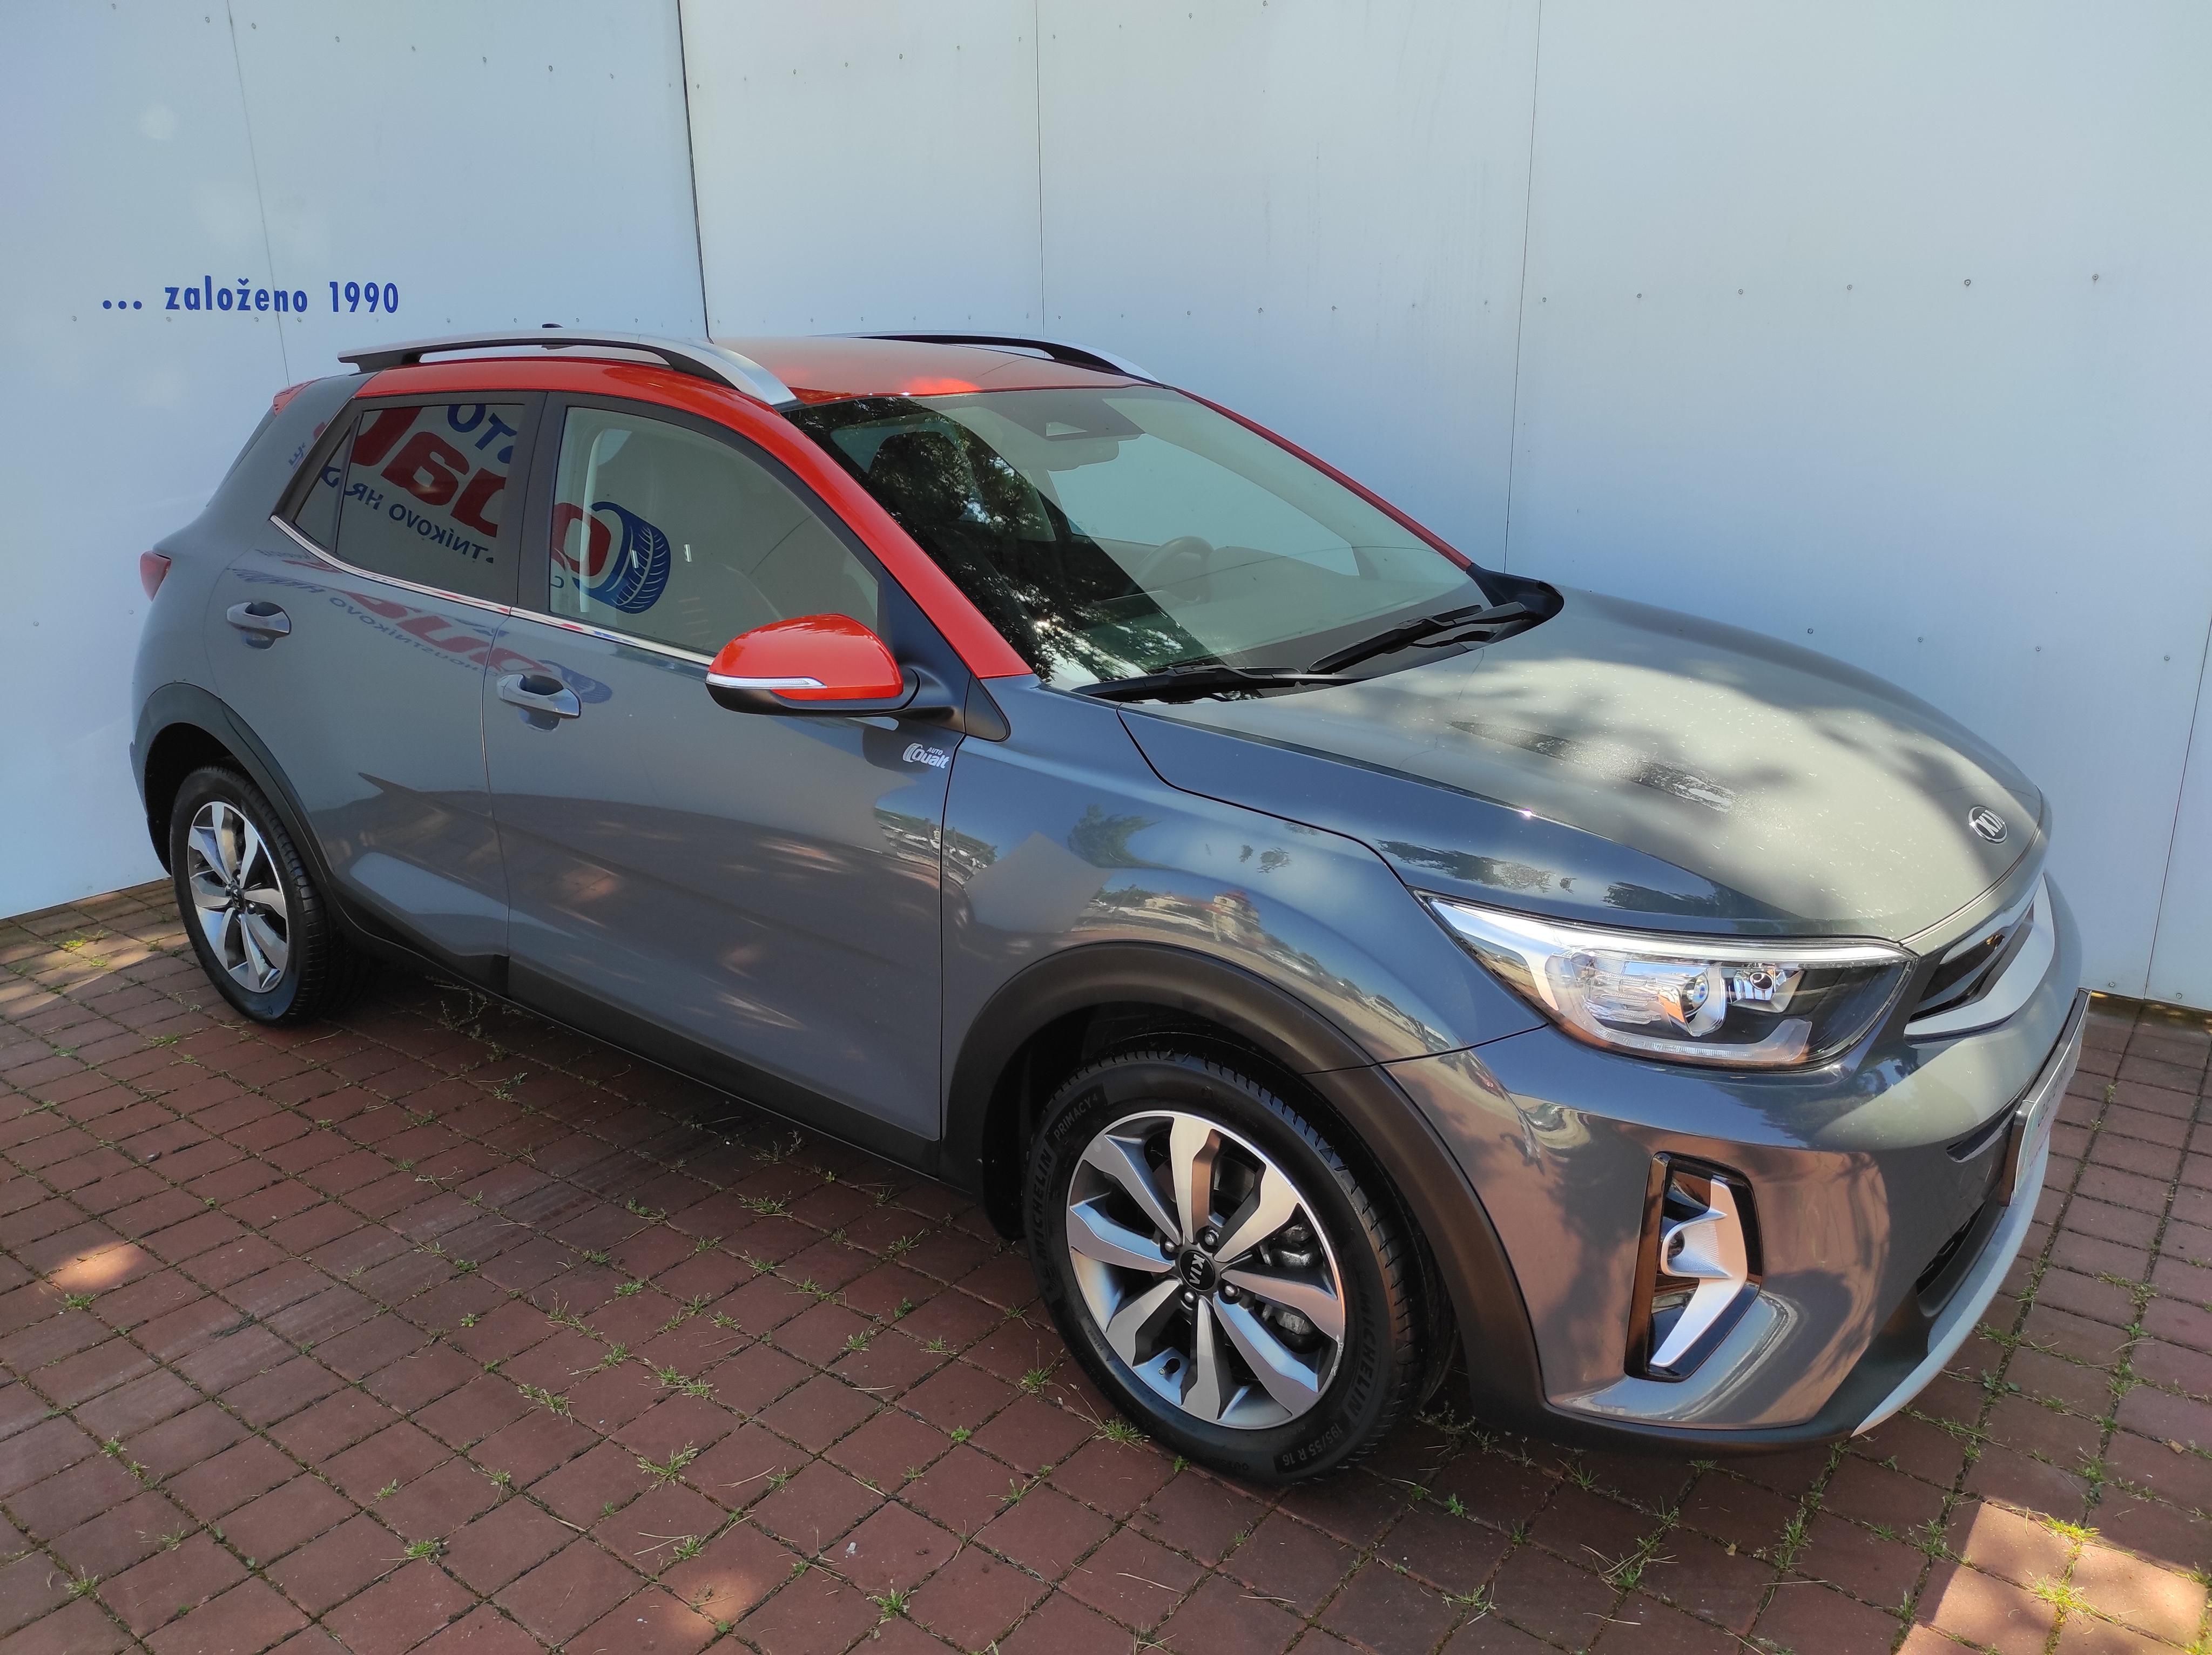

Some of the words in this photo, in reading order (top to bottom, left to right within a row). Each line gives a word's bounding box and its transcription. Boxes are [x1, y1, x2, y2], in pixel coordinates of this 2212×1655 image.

[165, 275, 308, 312] založeno
[329, 281, 399, 314] 1990
[927, 747, 943, 755] AUTO
[1974, 809, 2003, 837] KIA
[1053, 1097, 1092, 1141] PRIMACY
[1032, 1148, 1052, 1260] MICHELIN
[1189, 1254, 1205, 1285] KIA
[1347, 1291, 1377, 1418] MICHELIN
[1298, 1448, 1307, 1461] R
[1308, 1422, 1343, 1456] 195/55
[1282, 1452, 1296, 1466] 16
